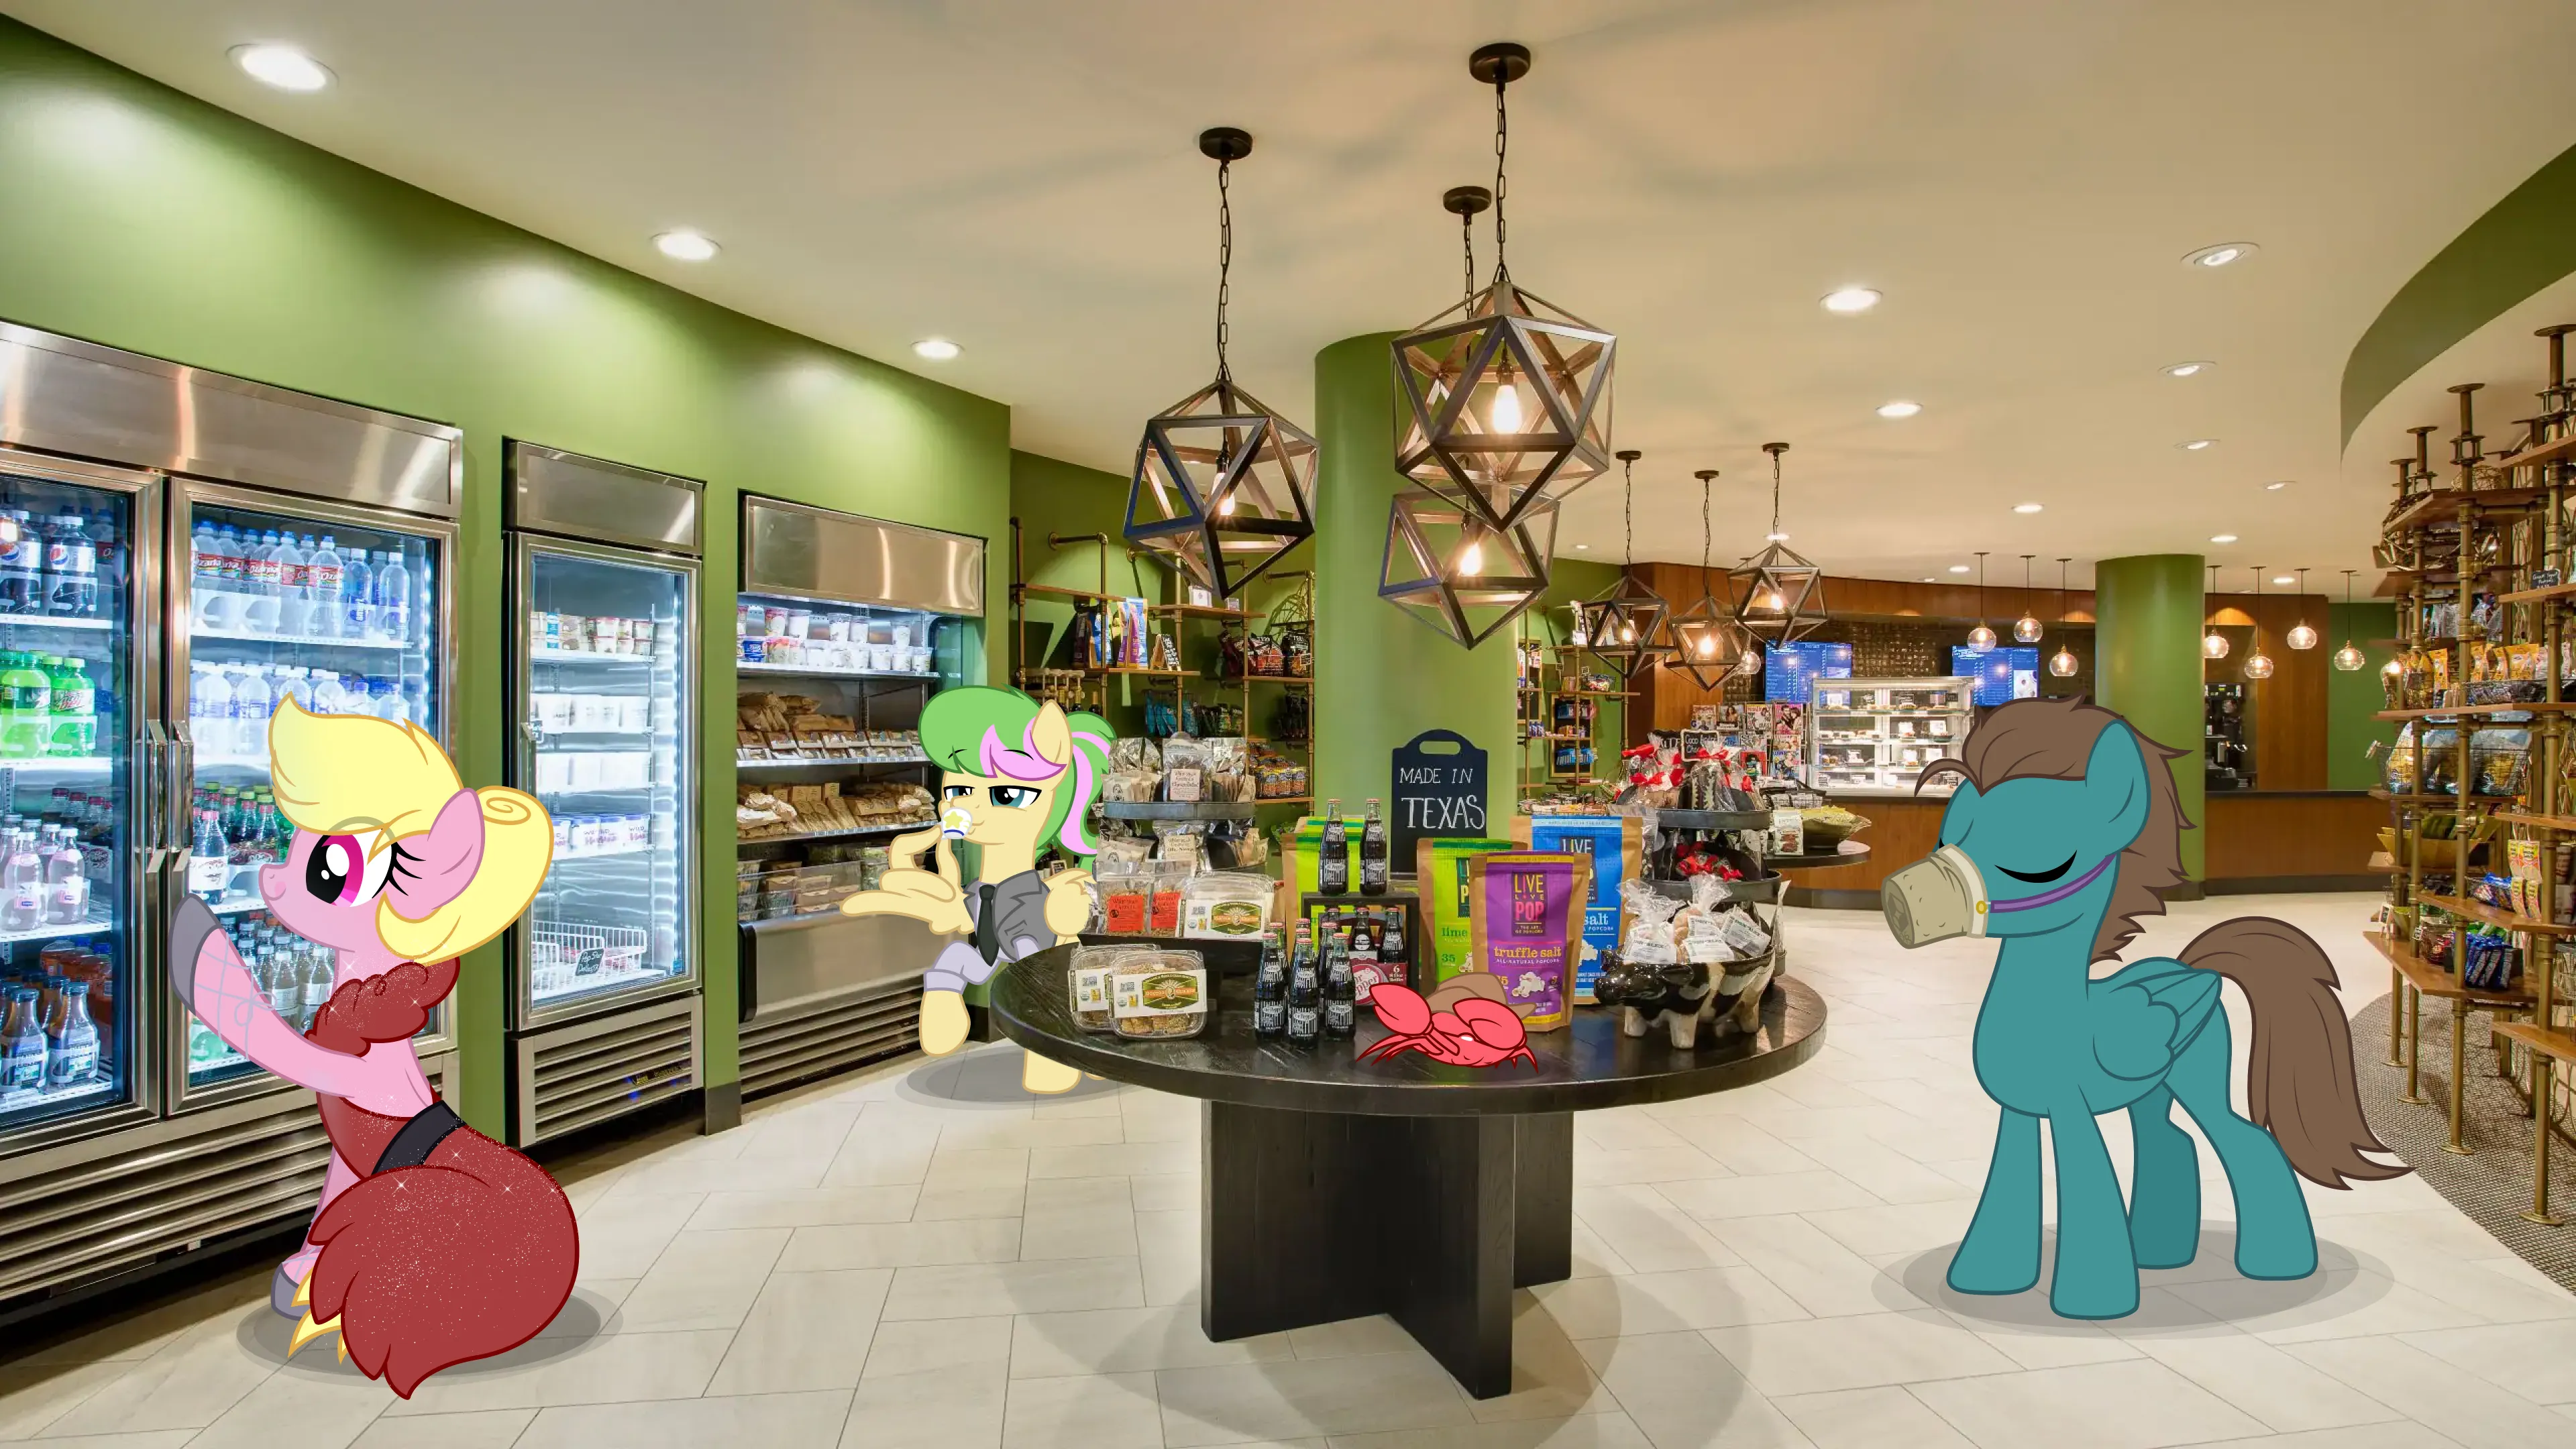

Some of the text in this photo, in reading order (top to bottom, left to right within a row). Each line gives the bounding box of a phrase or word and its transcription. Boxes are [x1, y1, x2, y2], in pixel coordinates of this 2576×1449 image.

[1399, 767, 1474, 784] MADE IN
[1401, 794, 1486, 830] TEXAS
[1515, 873, 1544, 893] LIVE
[1515, 901, 1544, 922] POP
[1584, 913, 1609, 925] salt
[1442, 926, 1468, 937] lime
[1442, 953, 1456, 963] 35
[1494, 945, 1562, 959] truffle salt
